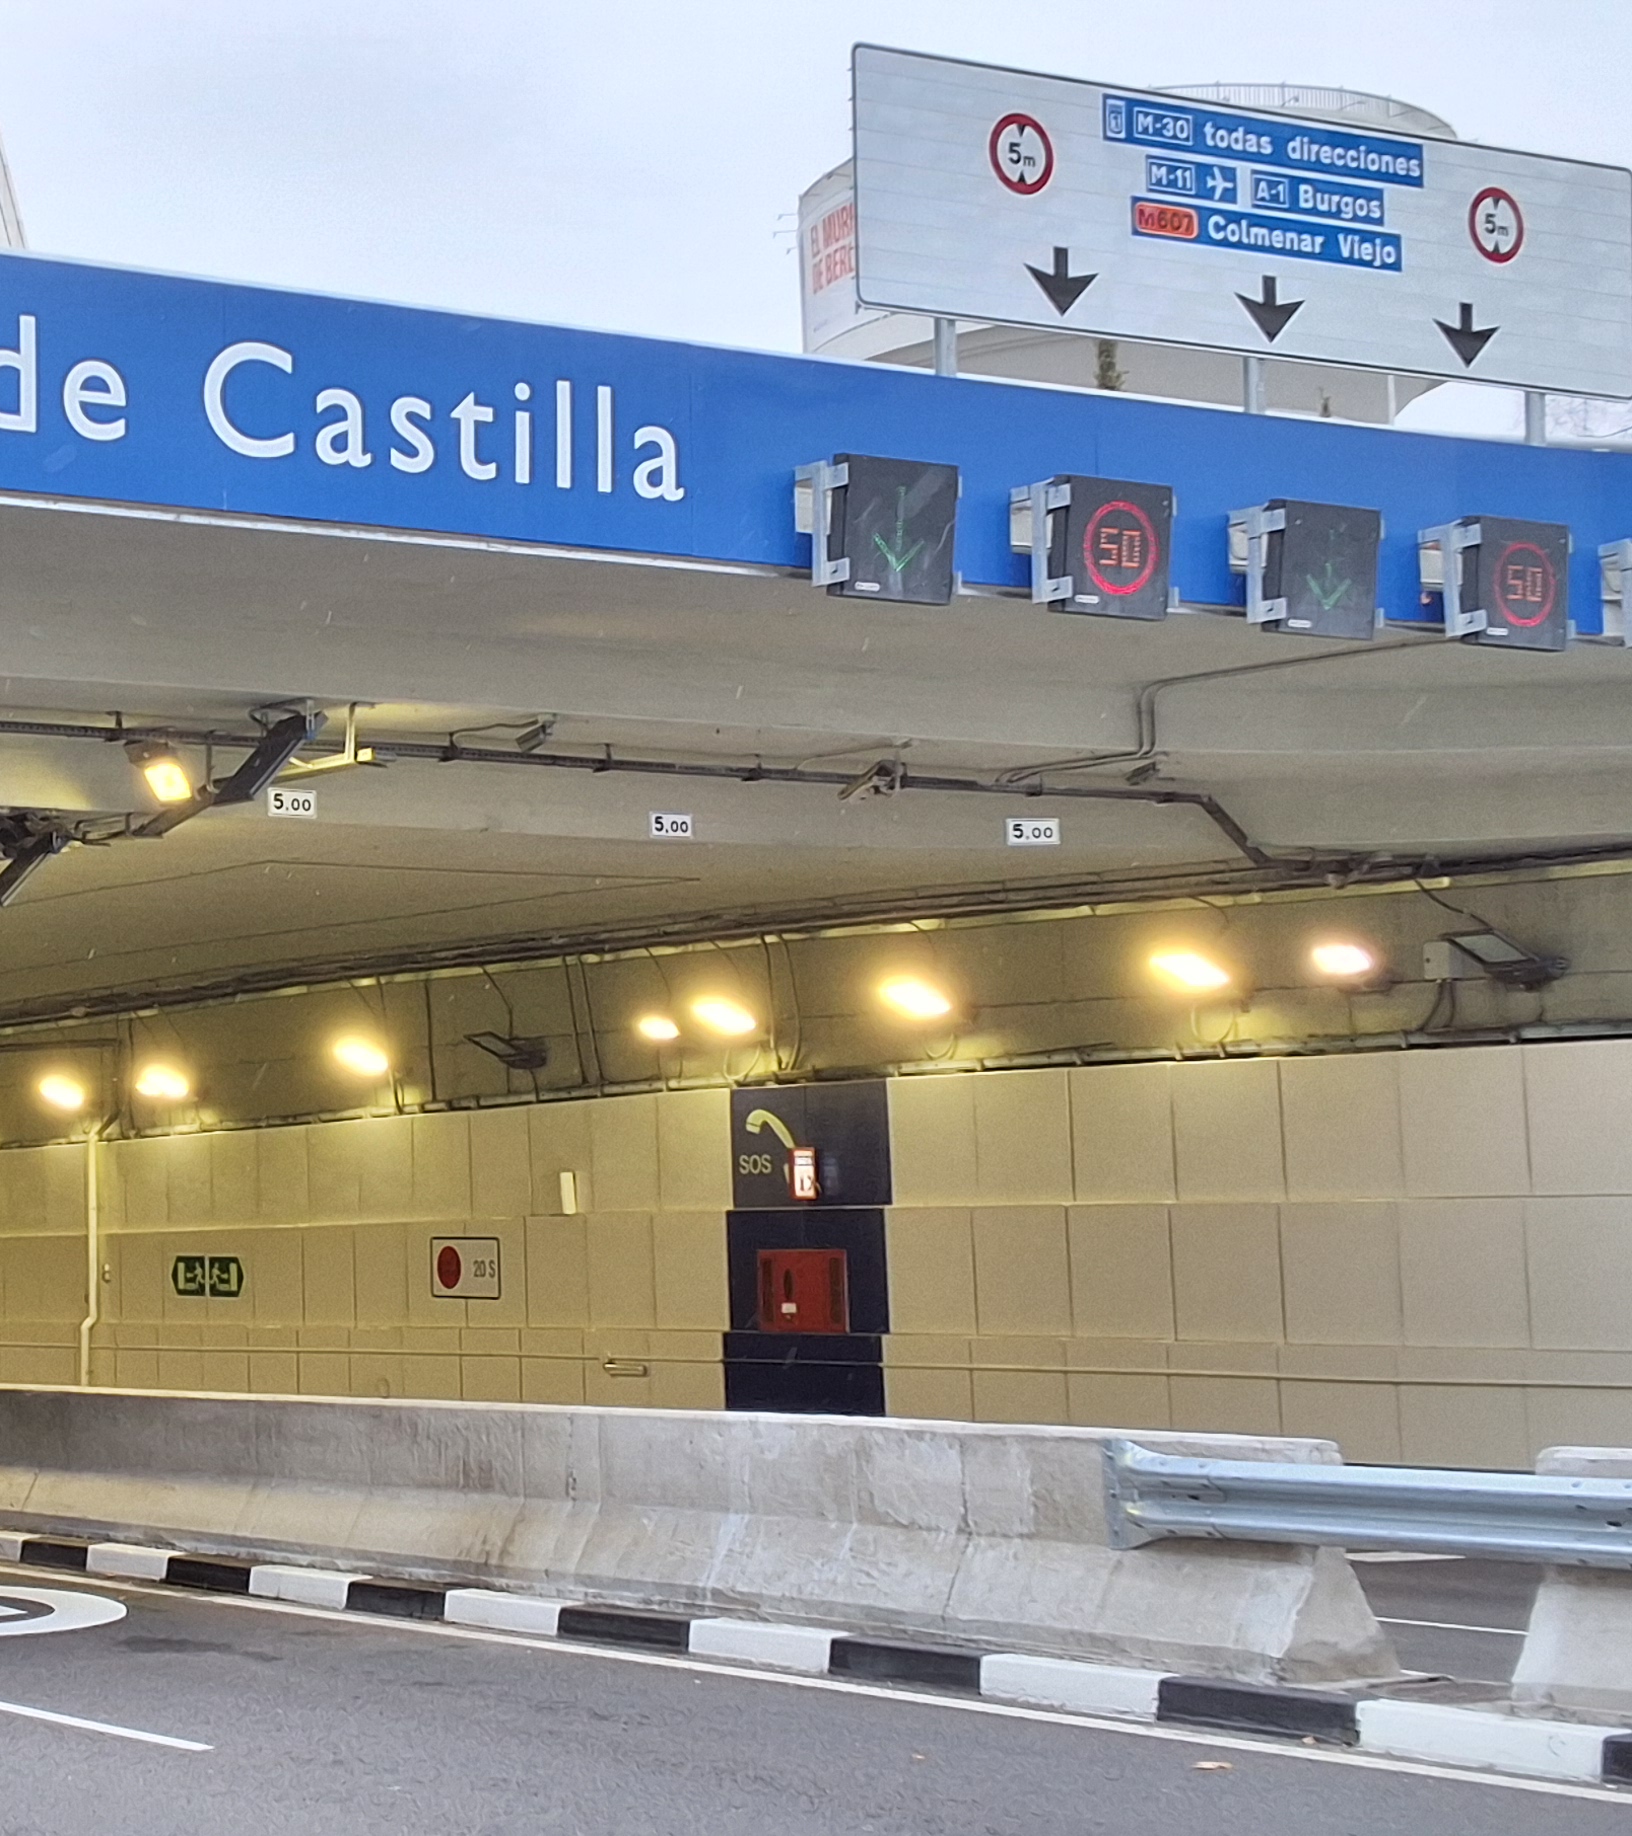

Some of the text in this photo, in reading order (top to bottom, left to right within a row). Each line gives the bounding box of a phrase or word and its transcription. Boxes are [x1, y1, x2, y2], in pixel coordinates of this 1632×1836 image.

[1136, 115, 1421, 178] M-30 todas direcciones
[1150, 165, 1194, 191] M-11
[1256, 181, 1382, 219] A-1 Burgos
[1207, 214, 1325, 254] Colmenar
[1338, 233, 1397, 267] Viejo
[203, 341, 685, 502] Castilla
[1099, 527, 1141, 569] 50
[1506, 564, 1543, 603] 50
[272, 792, 312, 813] 5.00
[1012, 823, 1054, 839] 5.00
[739, 1154, 772, 1175] SOS
